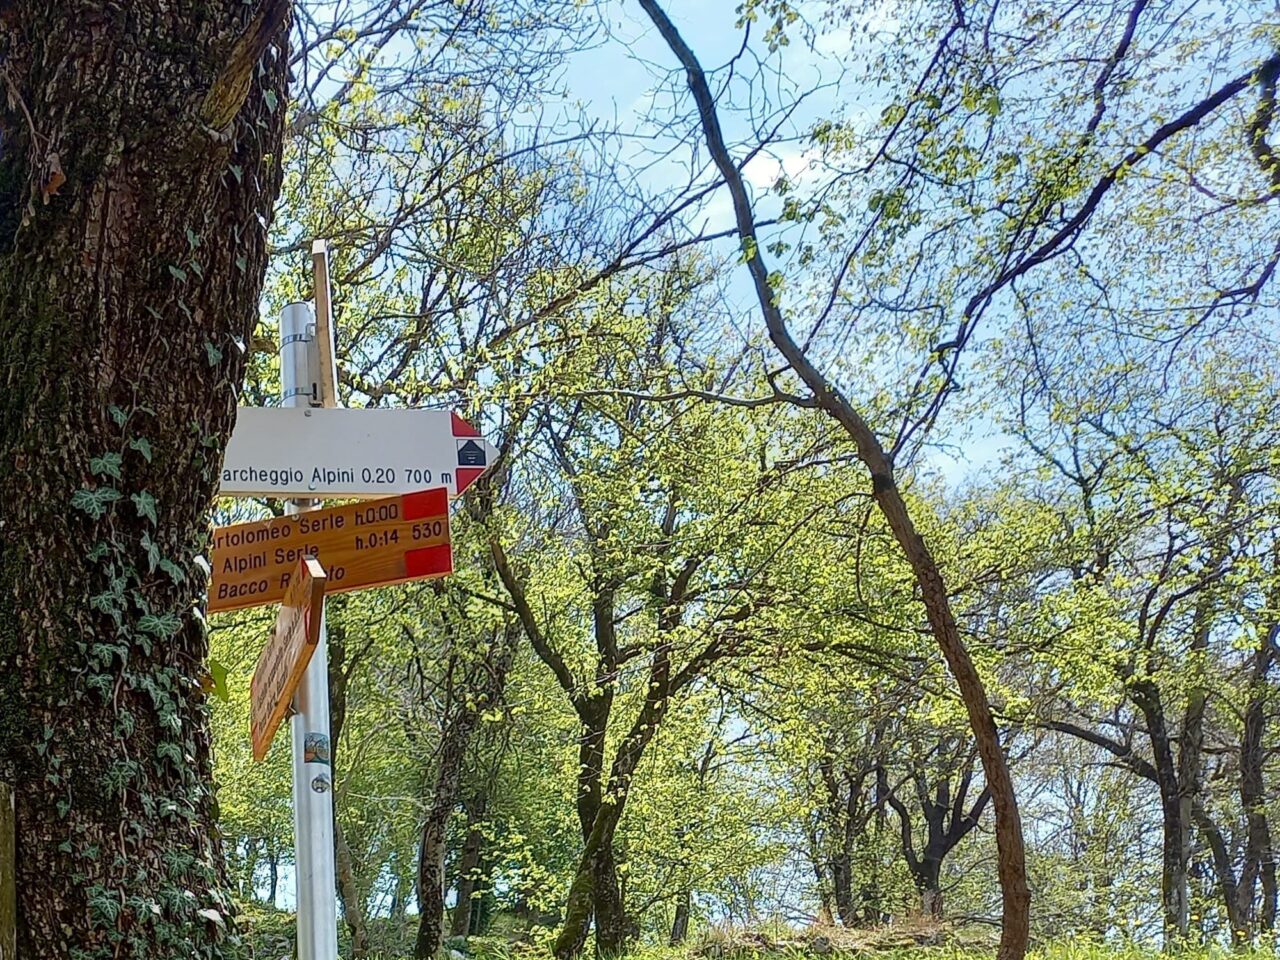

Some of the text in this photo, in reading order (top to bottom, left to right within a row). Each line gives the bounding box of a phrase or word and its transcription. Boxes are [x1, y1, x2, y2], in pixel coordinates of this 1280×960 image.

[223, 465, 453, 486] archeggio Alpini 0.20 700 m
[299, 513, 345, 535] Serle
[223, 521, 442, 575] Alpini Serle h.0:14 530
[218, 579, 268, 600] Bacco
